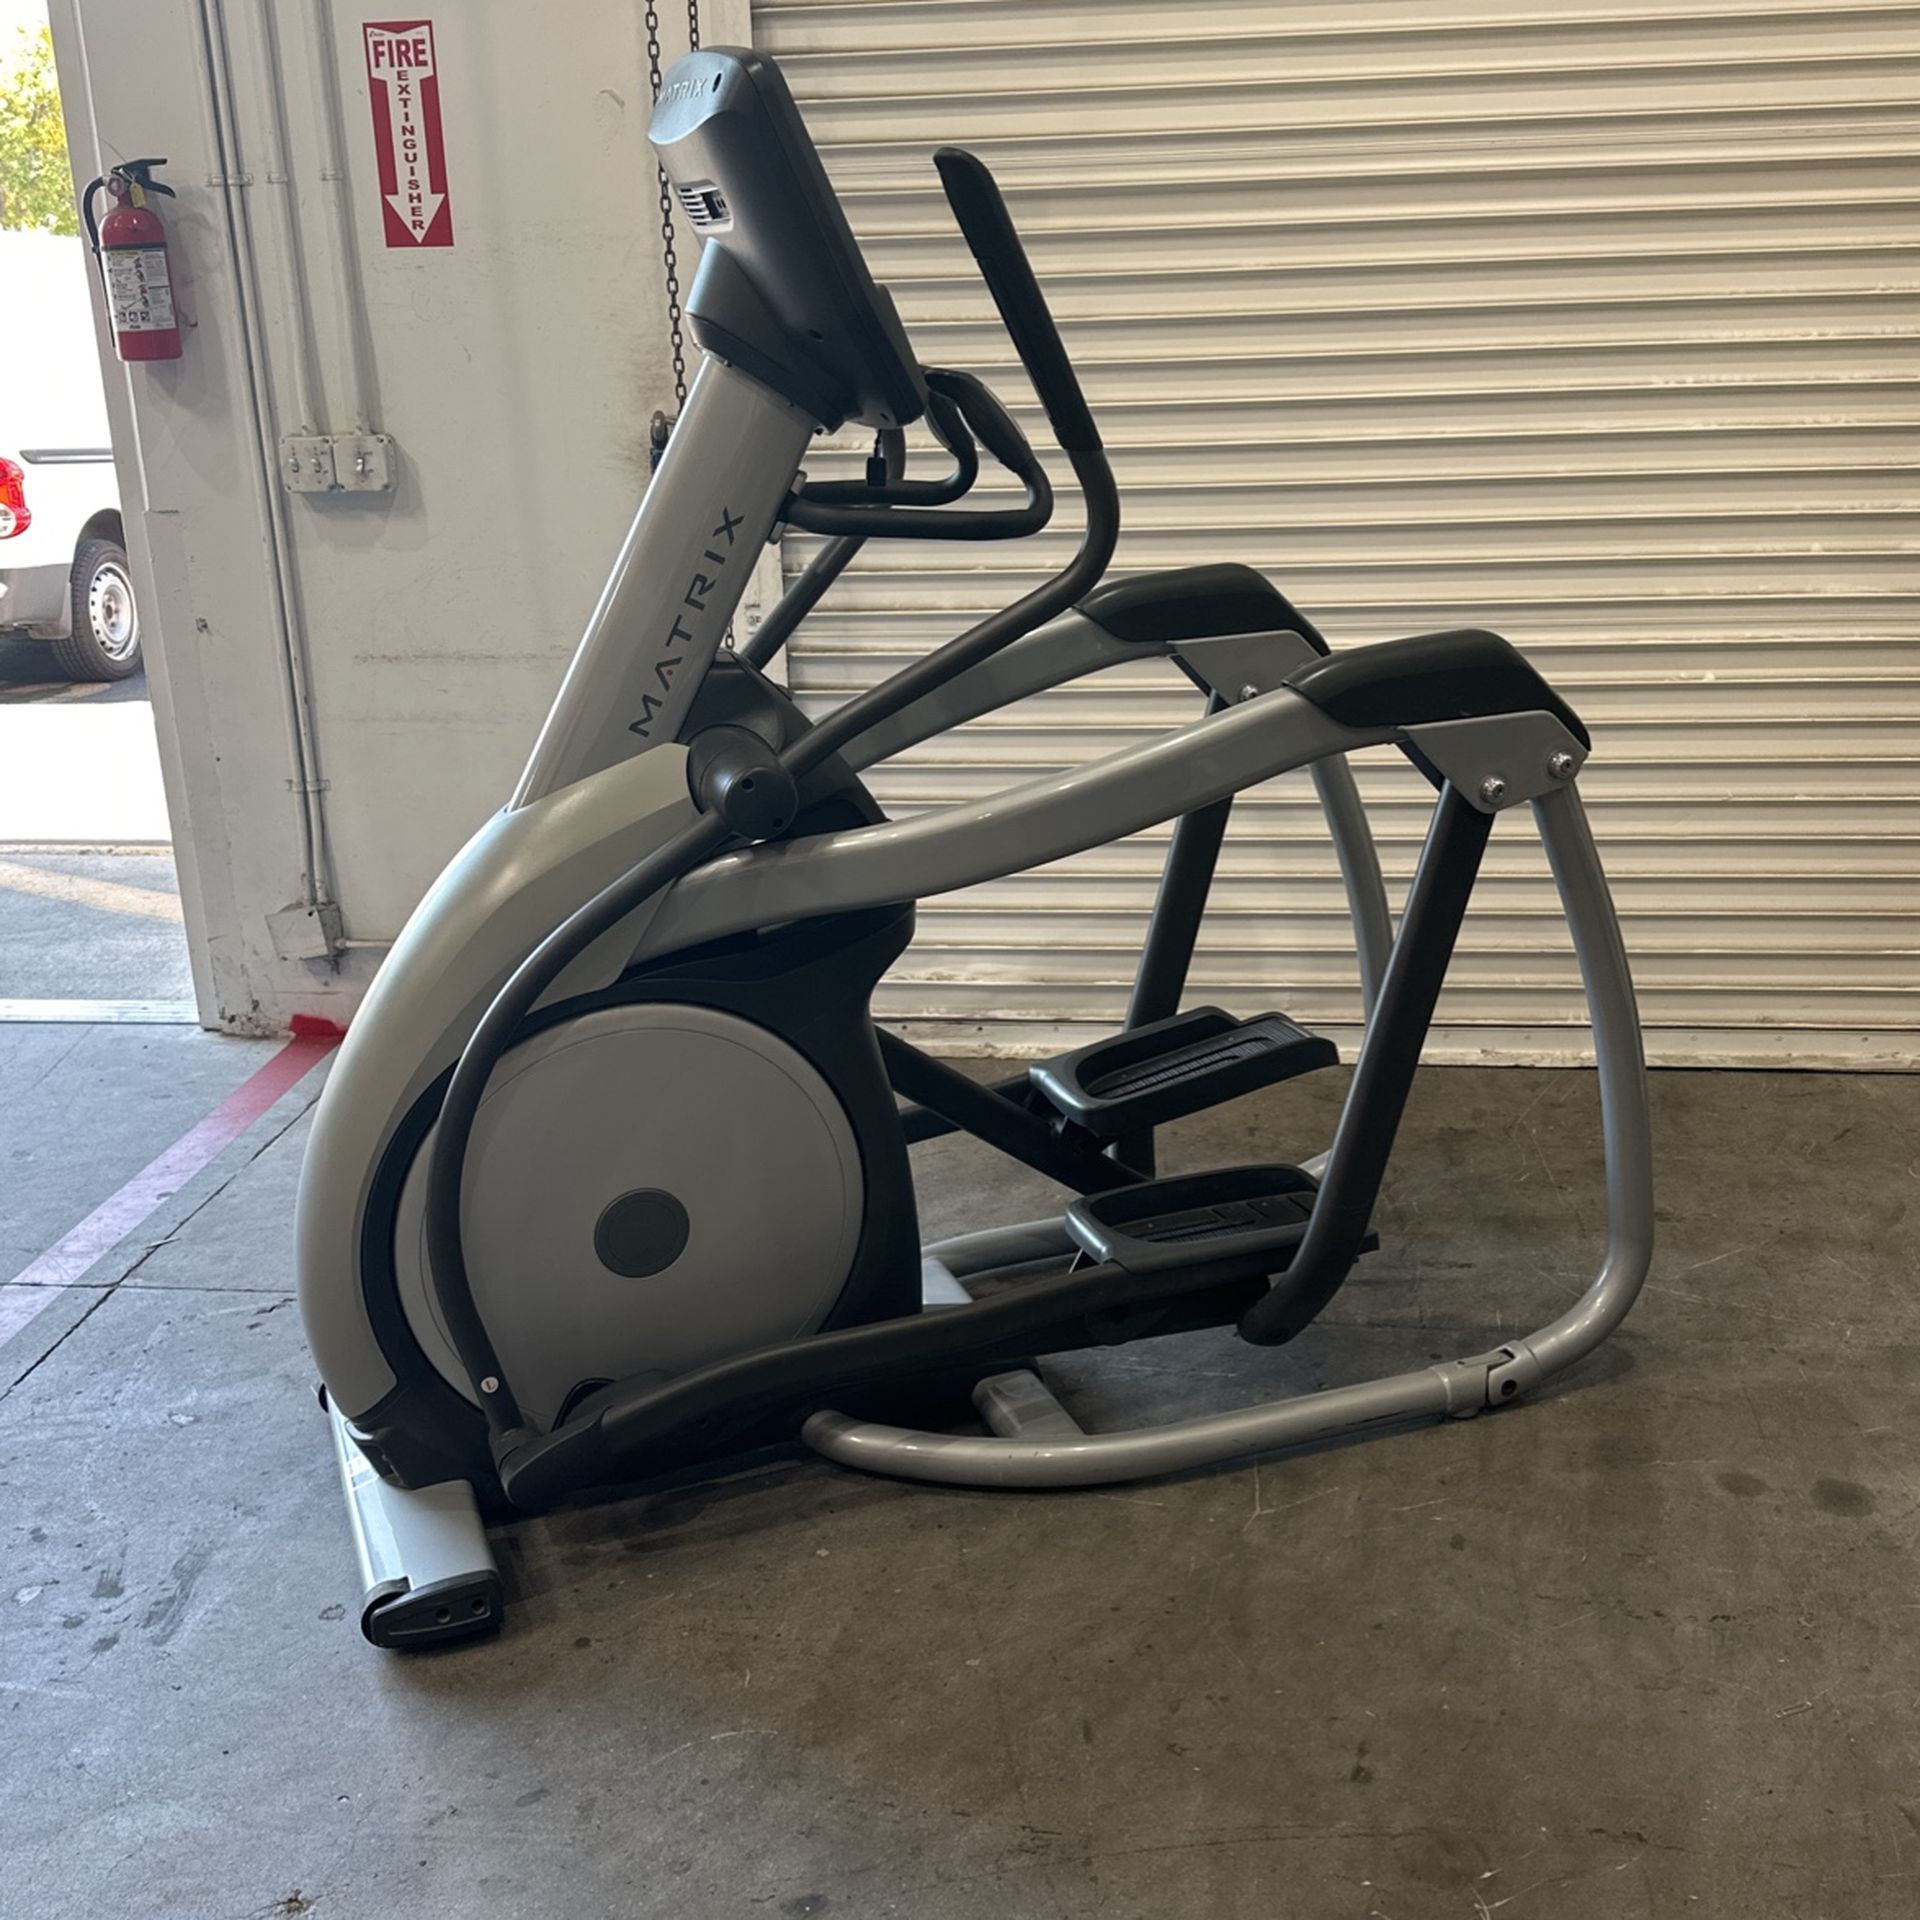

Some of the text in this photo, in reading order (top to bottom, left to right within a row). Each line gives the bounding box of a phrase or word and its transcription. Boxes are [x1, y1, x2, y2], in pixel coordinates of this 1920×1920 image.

[372, 38, 428, 68] FIRE
[397, 70, 425, 230] EXTINGUISHER
[629, 506, 745, 738] MATRIX
